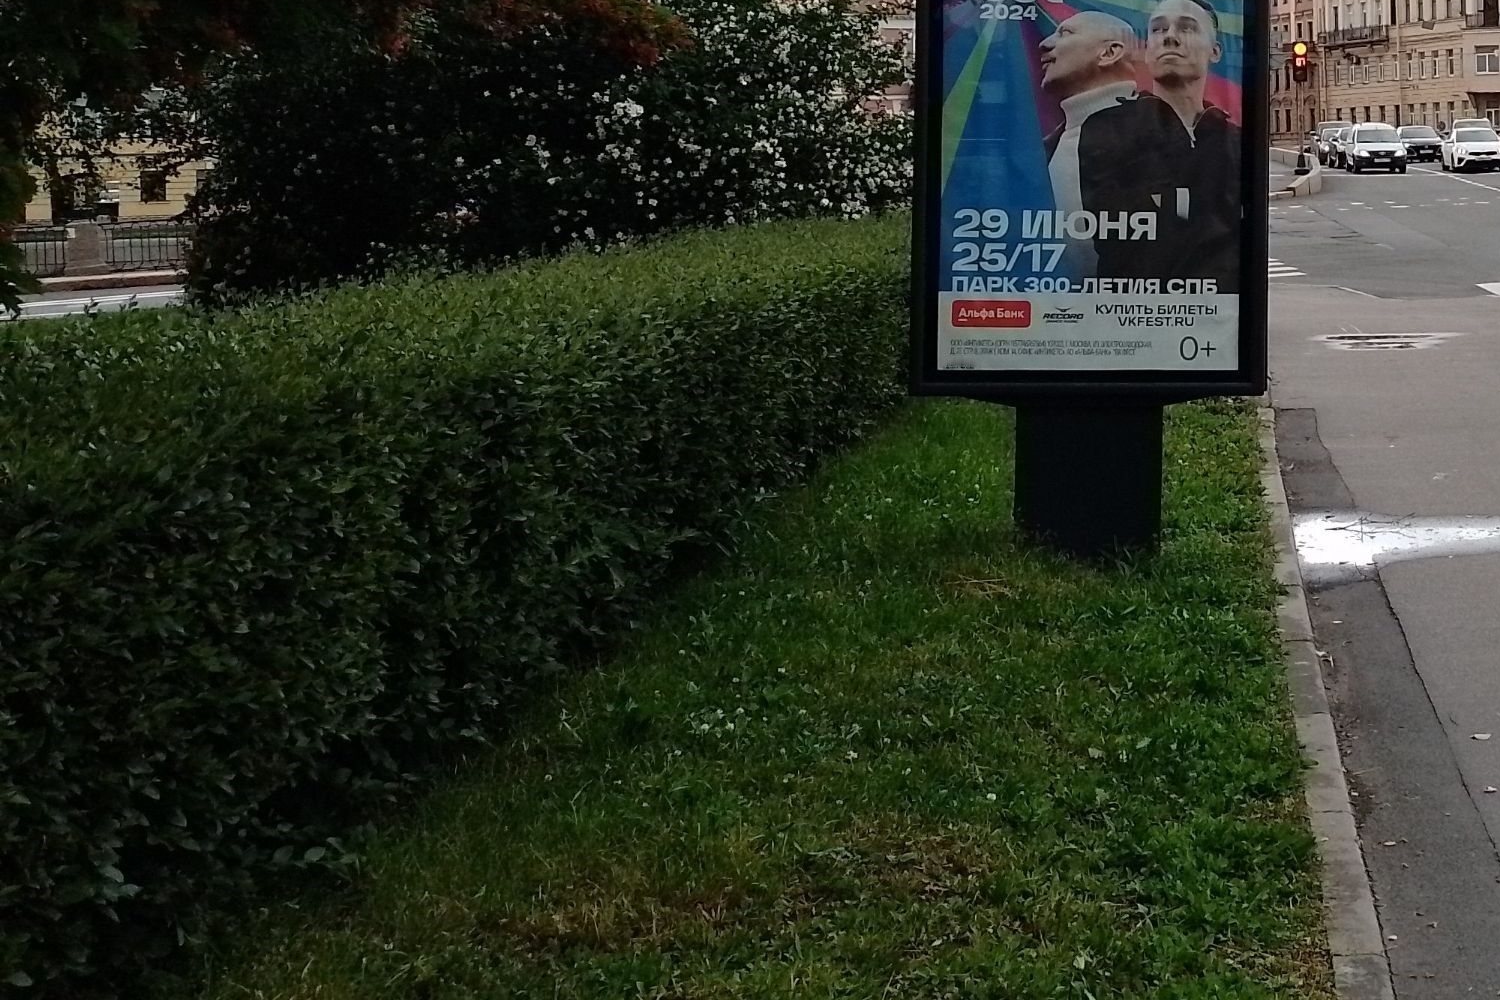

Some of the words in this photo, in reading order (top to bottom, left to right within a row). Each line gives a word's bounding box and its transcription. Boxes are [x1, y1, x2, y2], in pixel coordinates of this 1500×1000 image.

[979, 3, 1038, 20] 2024
[953, 208, 1009, 239] 29
[1022, 209, 1157, 240] ИЮНЯ
[951, 242, 1067, 272] 25/17
[952, 276, 1018, 294] ПАРК
[1024, 277, 1161, 294] 300-ЛЕТИЯ
[1166, 278, 1218, 295] СПБ
[958, 307, 995, 321] Альфа
[997, 307, 1025, 319] Банк
[1095, 304, 1153, 315] КУПИТЬ
[1157, 304, 1218, 315] БИЛЕТЫ
[1118, 316, 1194, 327] VKFEST.RU
[1180, 336, 1216, 360] 0+
